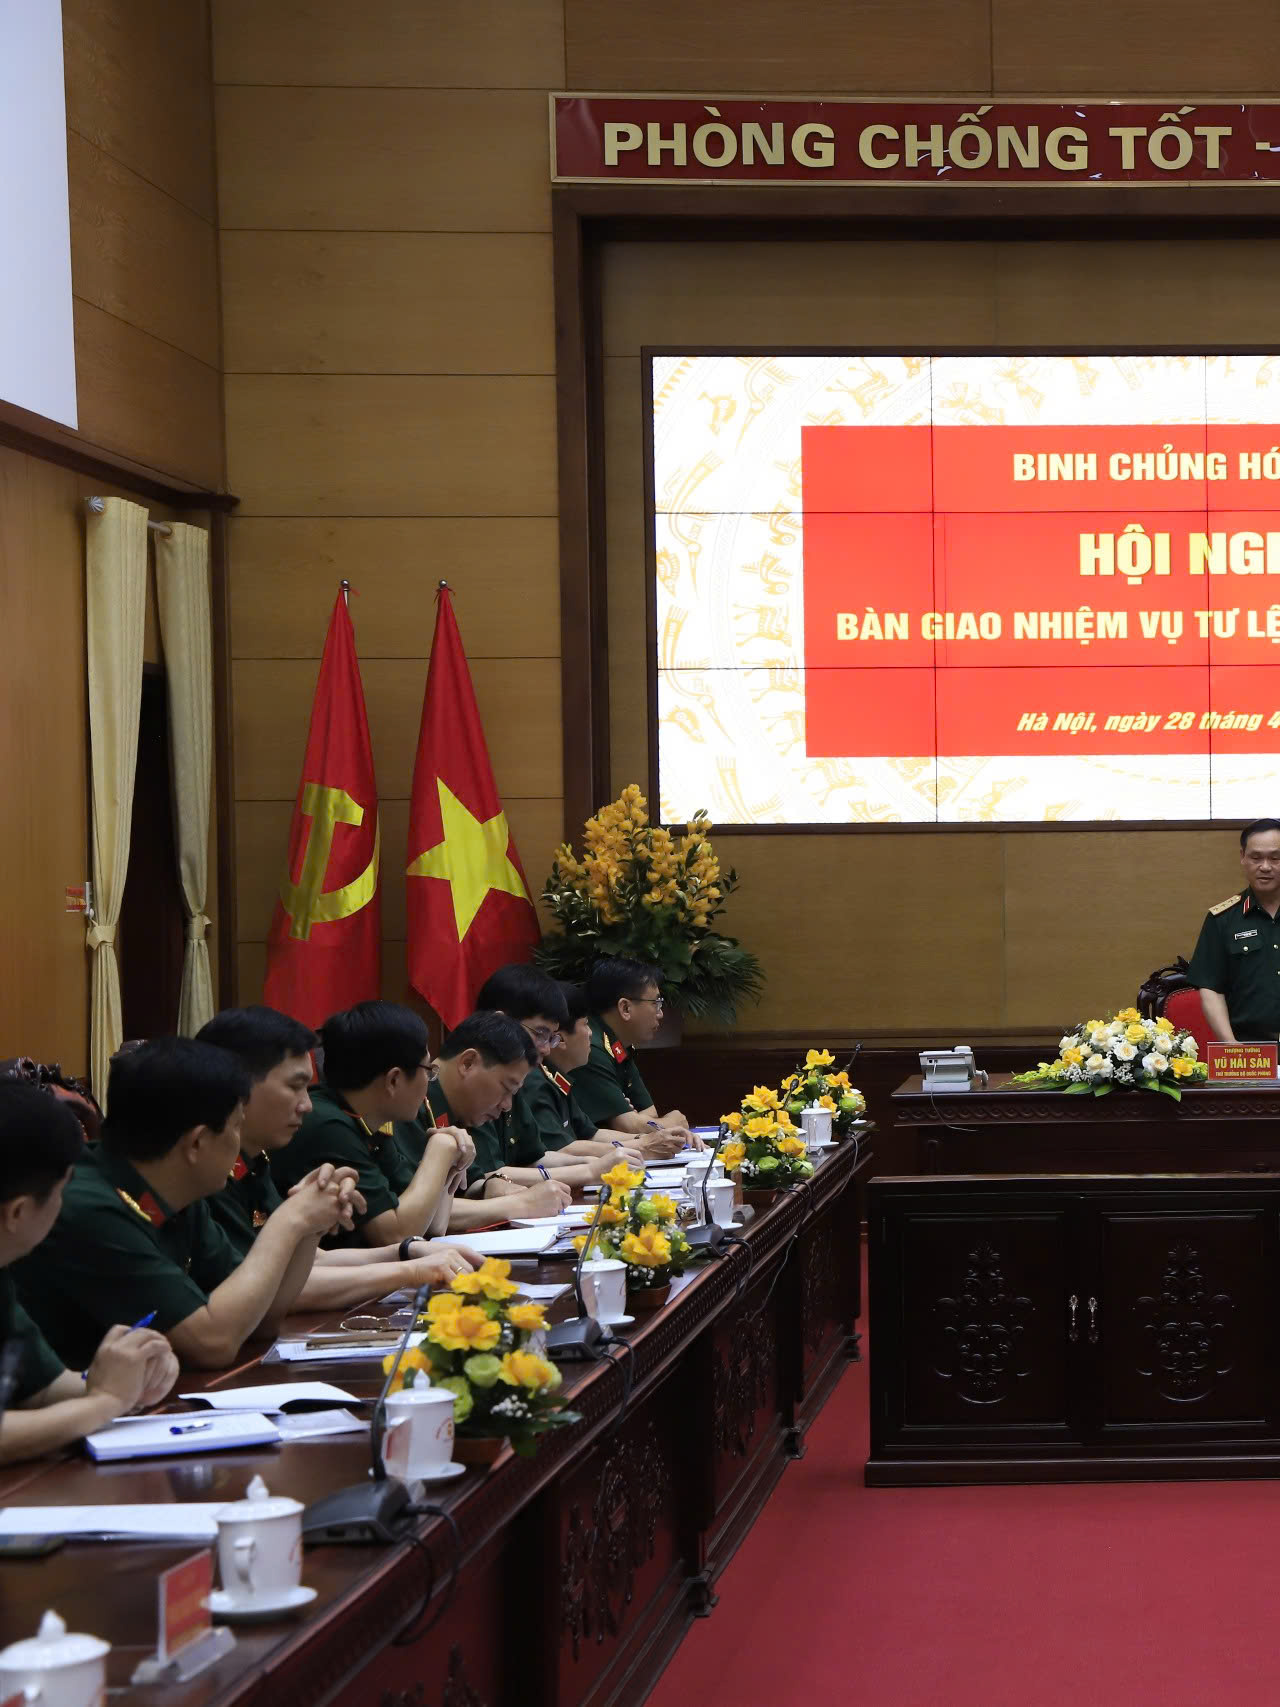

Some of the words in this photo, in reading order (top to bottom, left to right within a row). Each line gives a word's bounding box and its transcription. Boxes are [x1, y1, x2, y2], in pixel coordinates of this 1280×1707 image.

[605, 105, 835, 168] PHÒNG
[858, 105, 1089, 170] CHỐNG
[1108, 105, 1232, 170] TỐT
[1013, 453, 1097, 481] BINH
[1109, 444, 1227, 481] CHỦNG
[1079, 524, 1171, 585] HỘI
[836, 607, 909, 641] BÀN
[921, 612, 1002, 641] GIAO
[1013, 606, 1128, 645] NHIỆM
[1138, 610, 1184, 645] VỤ
[1194, 607, 1241, 641] TƯ
[1016, 712, 1049, 732] Hà
[1053, 710, 1097, 736] Nội,
[1103, 713, 1161, 736] ngày
[1165, 711, 1196, 732] 28
[1199, 710, 1264, 736] tháng
[1214, 1057, 1227, 1068] VŨ
[1230, 1054, 1247, 1068] HẢI
[1250, 1054, 1271, 1068] SẢN
